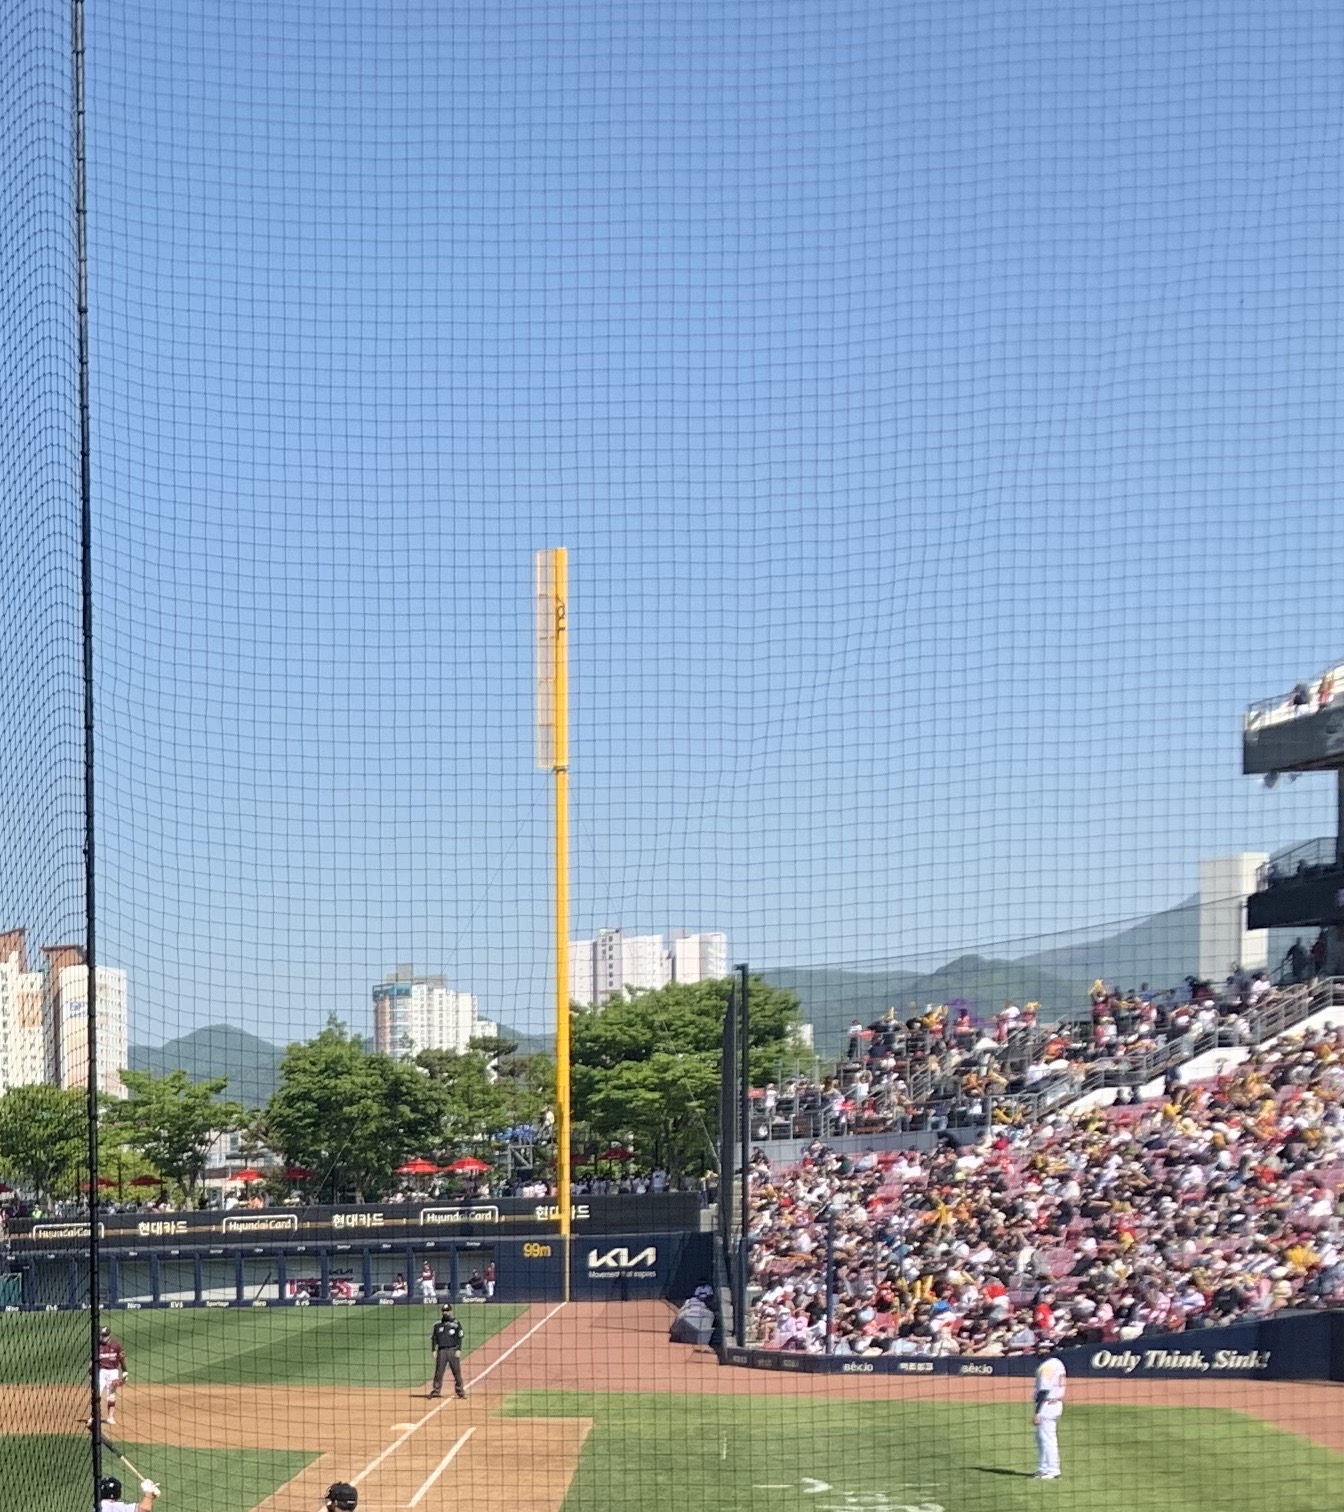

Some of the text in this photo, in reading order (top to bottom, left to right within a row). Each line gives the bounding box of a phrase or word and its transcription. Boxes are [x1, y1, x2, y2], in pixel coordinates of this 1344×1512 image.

[138, 1220, 189, 1236] 현대카드
[332, 1213, 385, 1228] 현대카드
[522, 1242, 552, 1258] 99m
[587, 1246, 657, 1268] KIA
[1092, 1348, 1271, 1374] Only Think, Sink!
